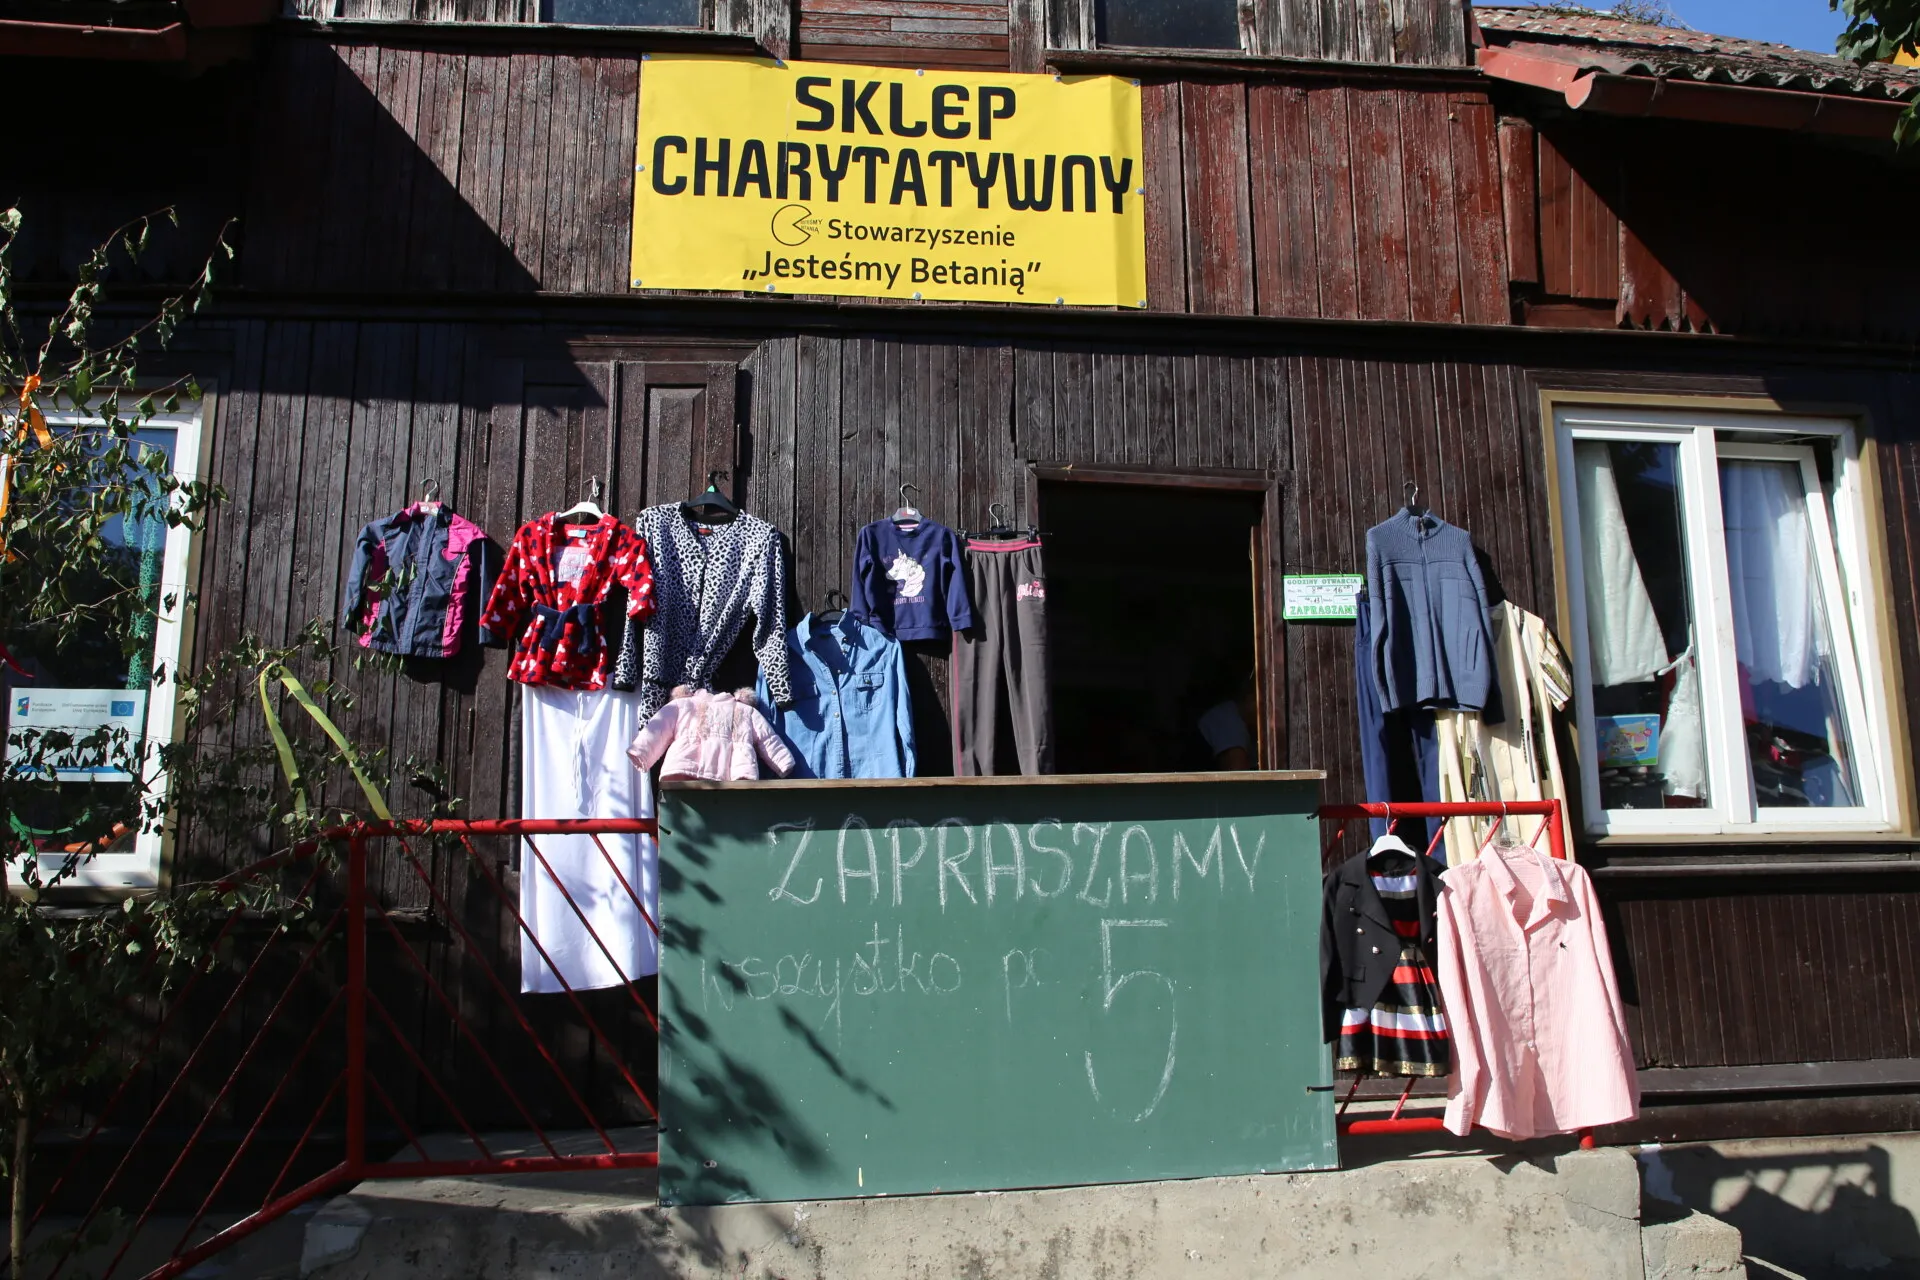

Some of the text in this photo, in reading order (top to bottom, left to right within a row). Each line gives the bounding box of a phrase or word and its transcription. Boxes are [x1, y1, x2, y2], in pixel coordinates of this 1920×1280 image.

[796, 76, 1016, 140] SKLEP
[653, 136, 1134, 214] CHARYTATYWNY
[827, 218, 1015, 249] Stowarzyszenie
[768, 814, 1266, 912] ZAPRASZAMY
[1086, 918, 1177, 1122] 5
